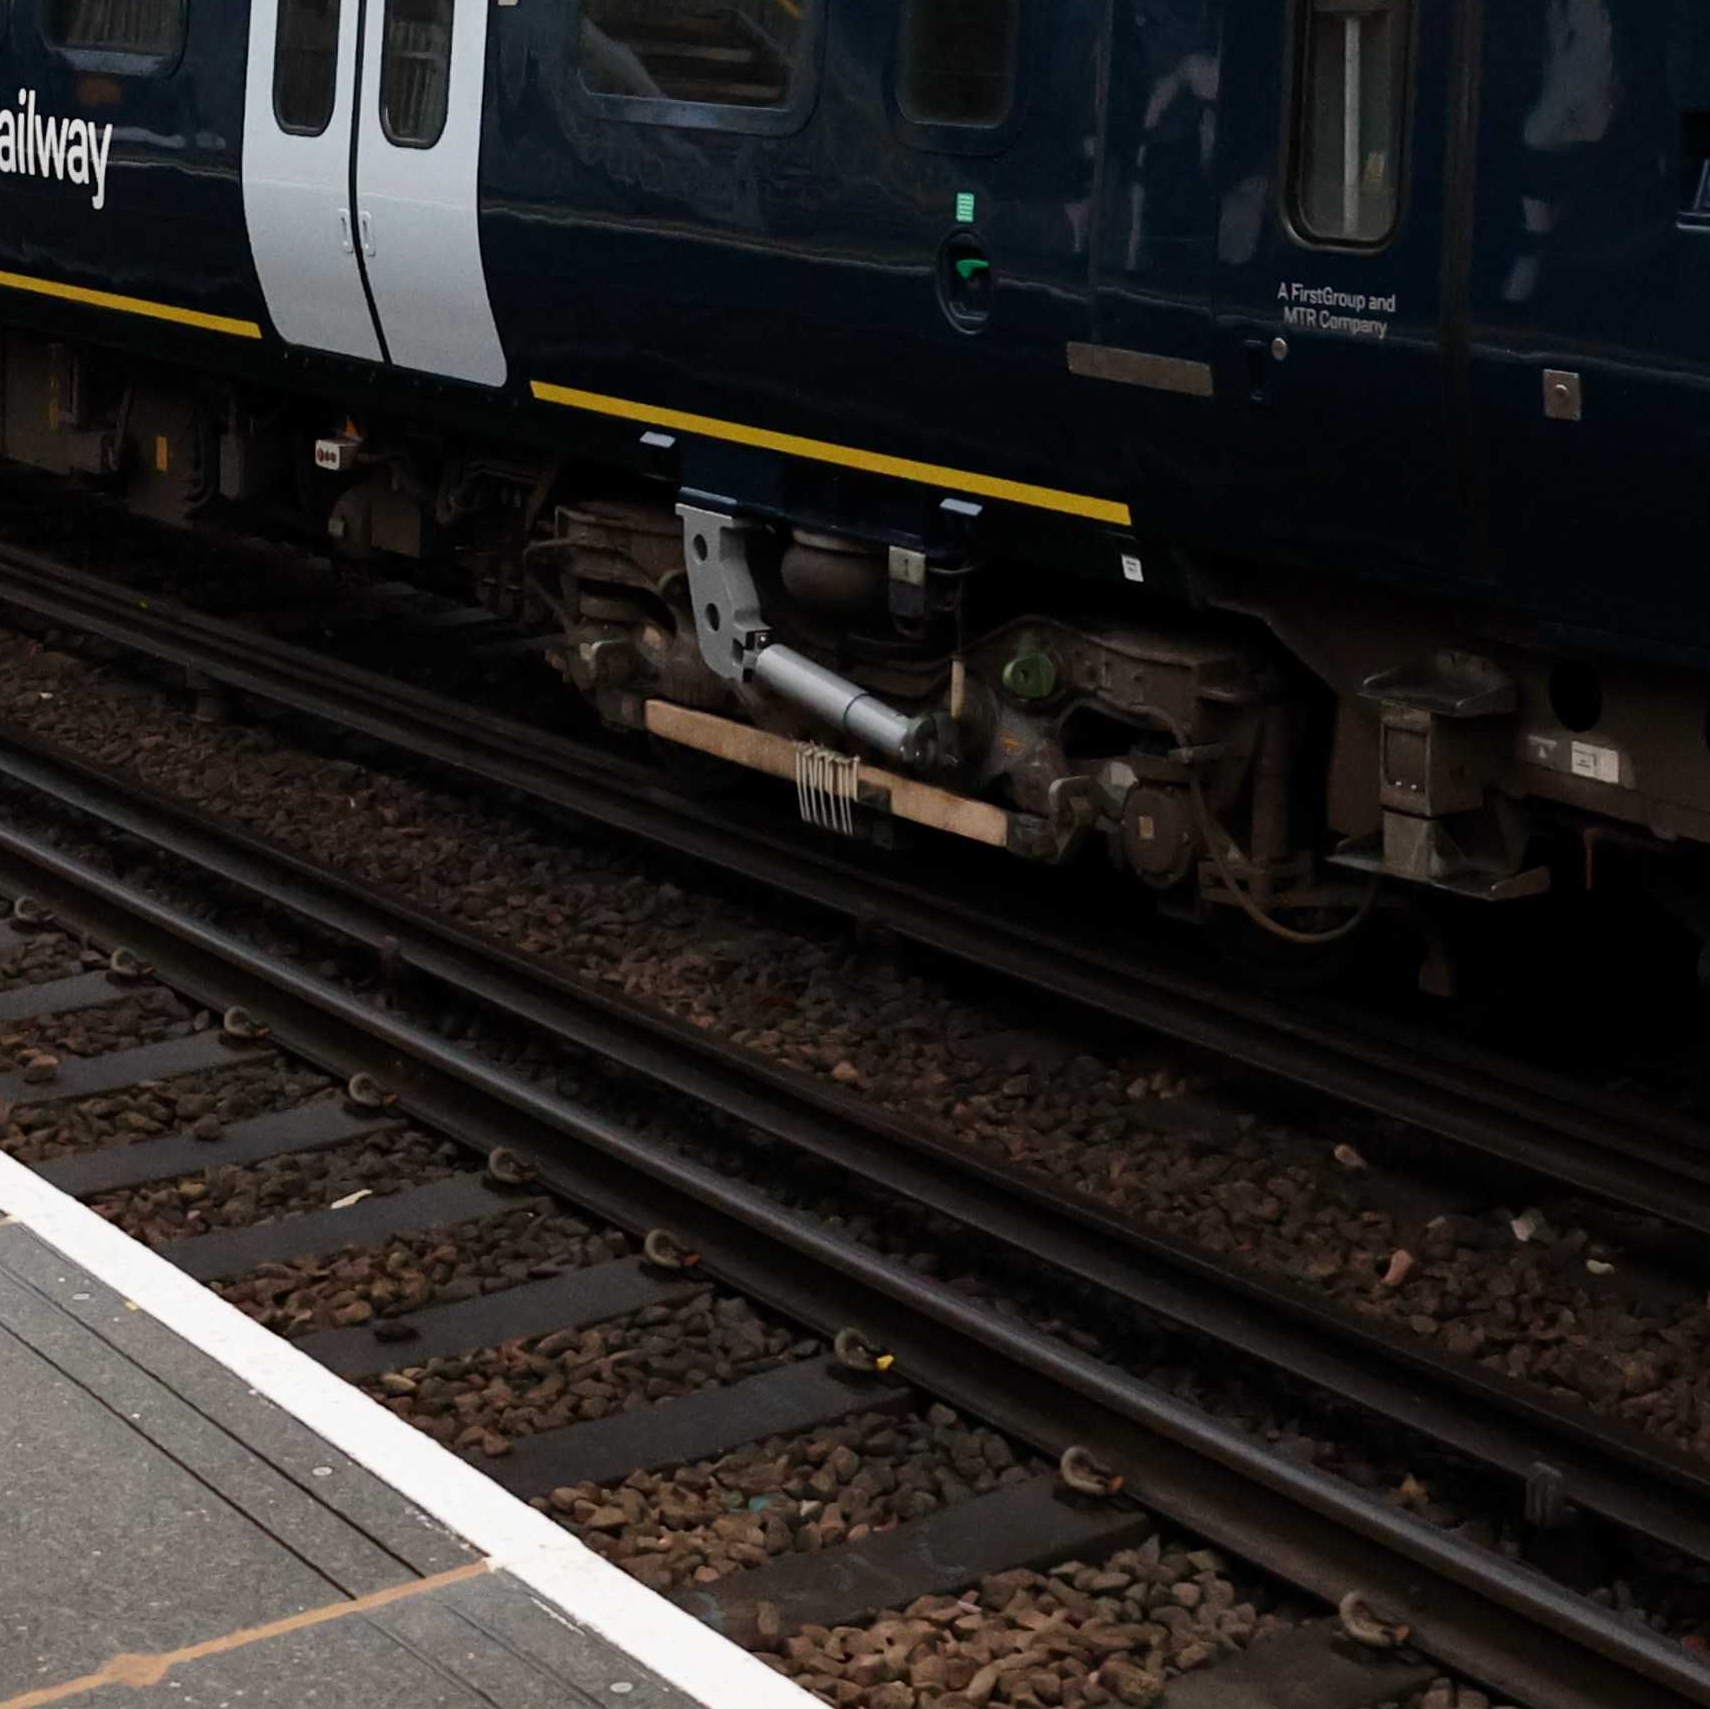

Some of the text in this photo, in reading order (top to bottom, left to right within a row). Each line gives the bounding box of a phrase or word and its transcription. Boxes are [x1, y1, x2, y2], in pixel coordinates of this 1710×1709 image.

[1276, 281, 1397, 313] A FirstGroup and
[1283, 306, 1388, 340] MTR Company
